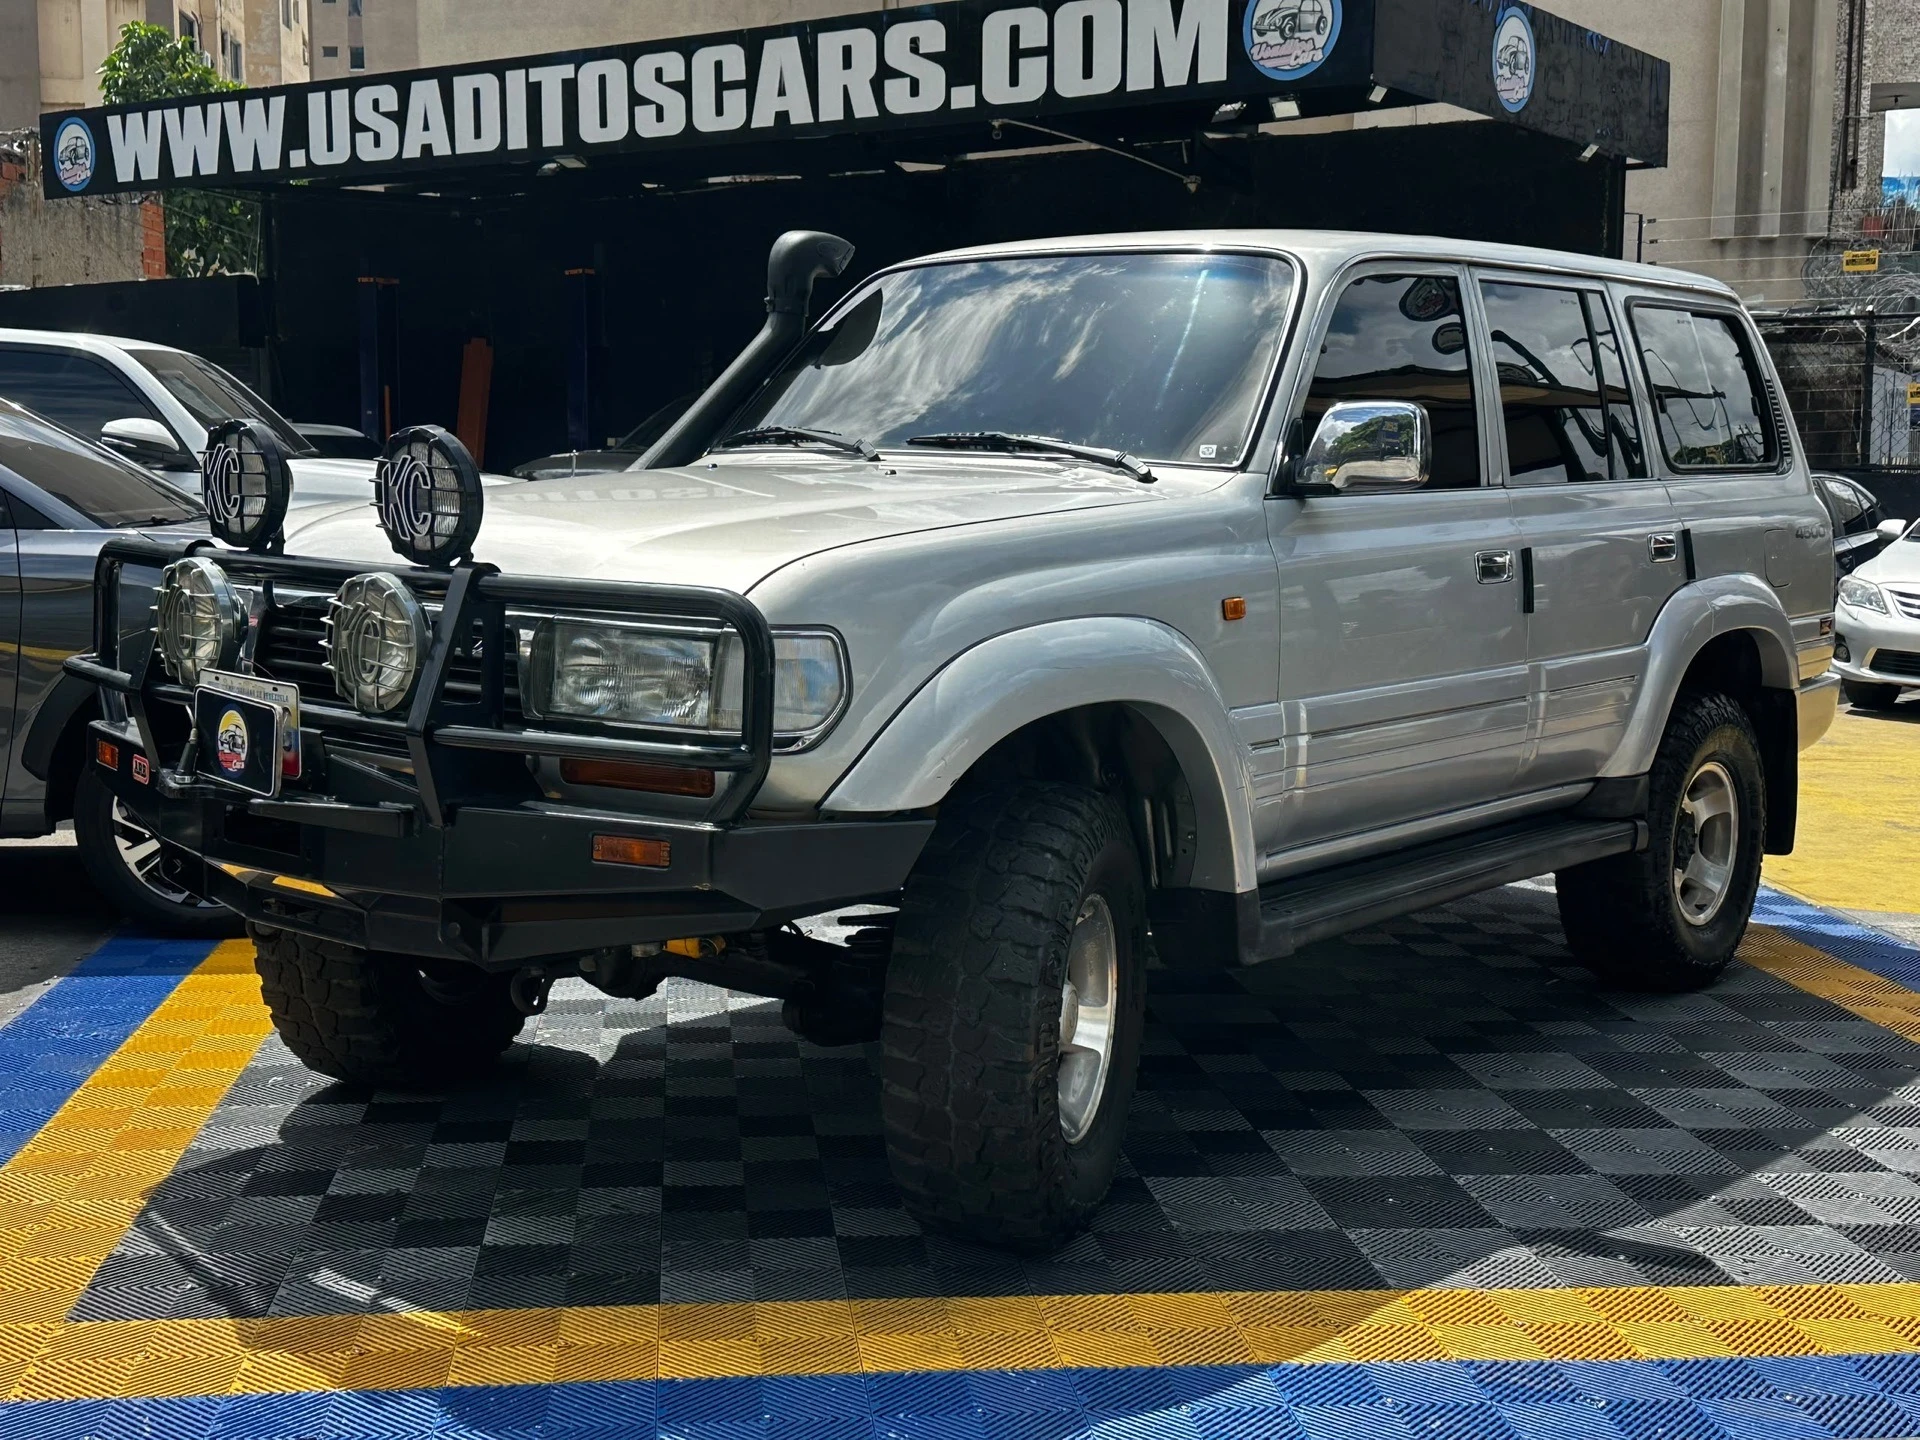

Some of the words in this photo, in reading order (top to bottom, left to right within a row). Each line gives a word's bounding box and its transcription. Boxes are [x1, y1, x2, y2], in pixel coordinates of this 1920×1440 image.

[106, 0, 1229, 183] WWW.USADITOSCARS.COM
[202, 443, 240, 524] KC
[381, 455, 431, 540] KC
[1795, 525, 1826, 539] 4500
